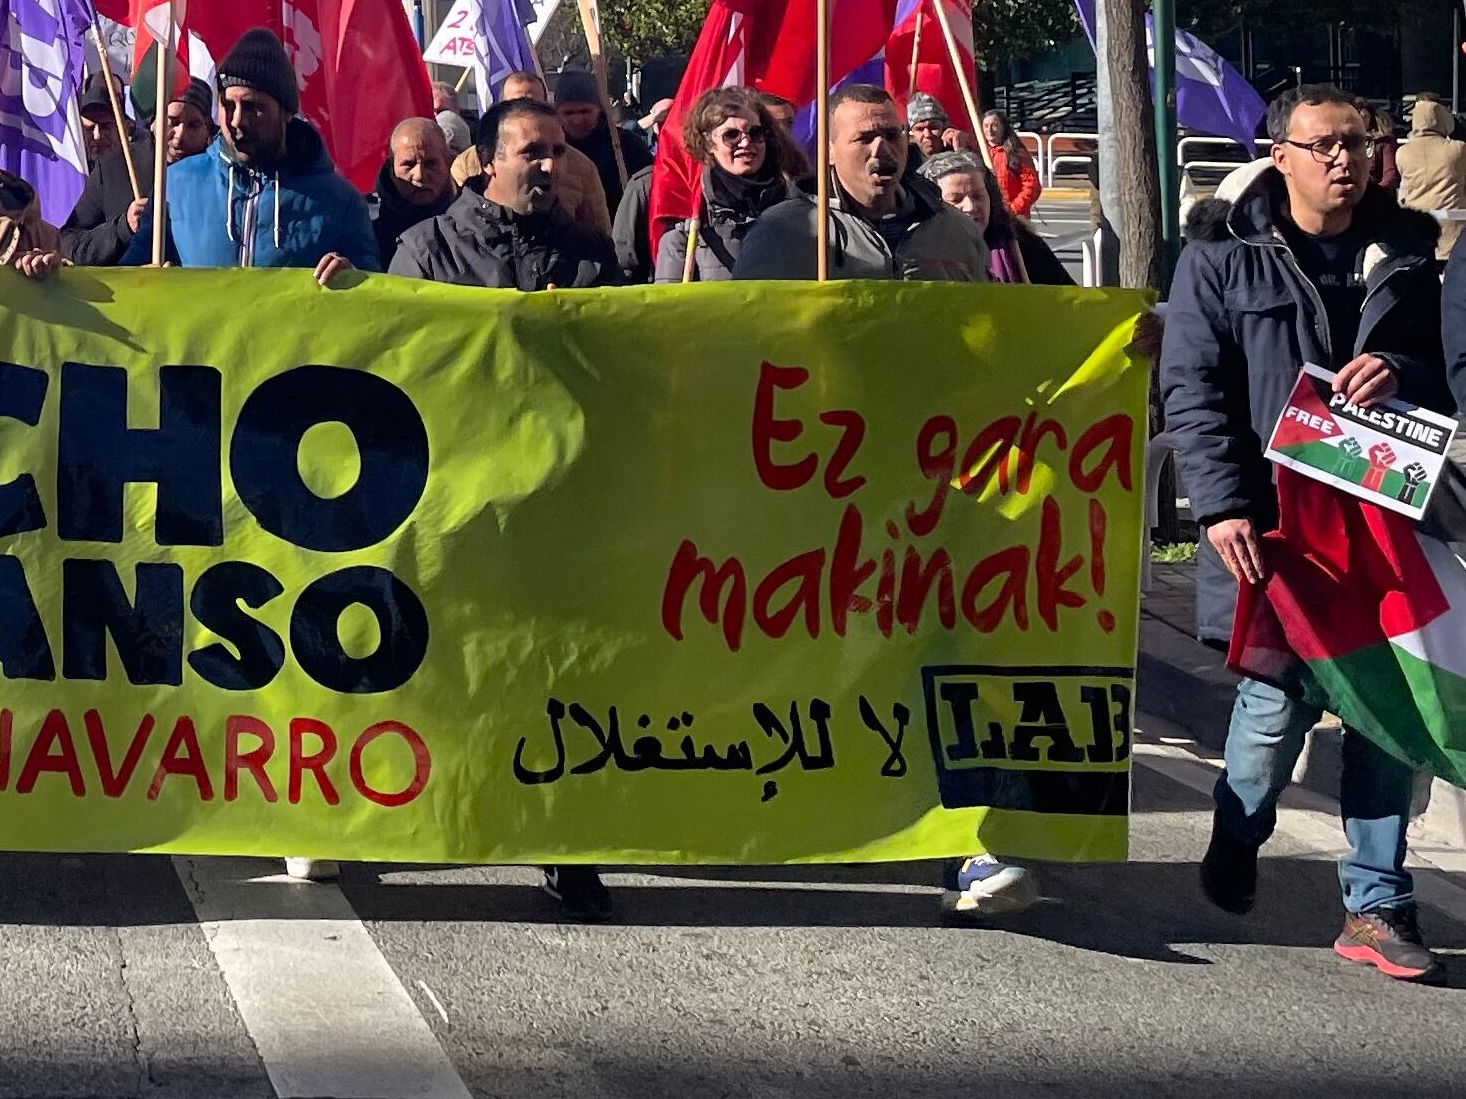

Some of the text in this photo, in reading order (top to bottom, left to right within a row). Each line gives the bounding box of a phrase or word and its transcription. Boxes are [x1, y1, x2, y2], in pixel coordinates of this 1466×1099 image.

[752, 359, 1134, 537] Ez gara
[1285, 405, 1335, 435] FREE
[1329, 392, 1444, 448] PALESTINE
[661, 494, 1116, 653] makinak!
[858, 695, 911, 778] لا
[938, 681, 1130, 764] LAB
